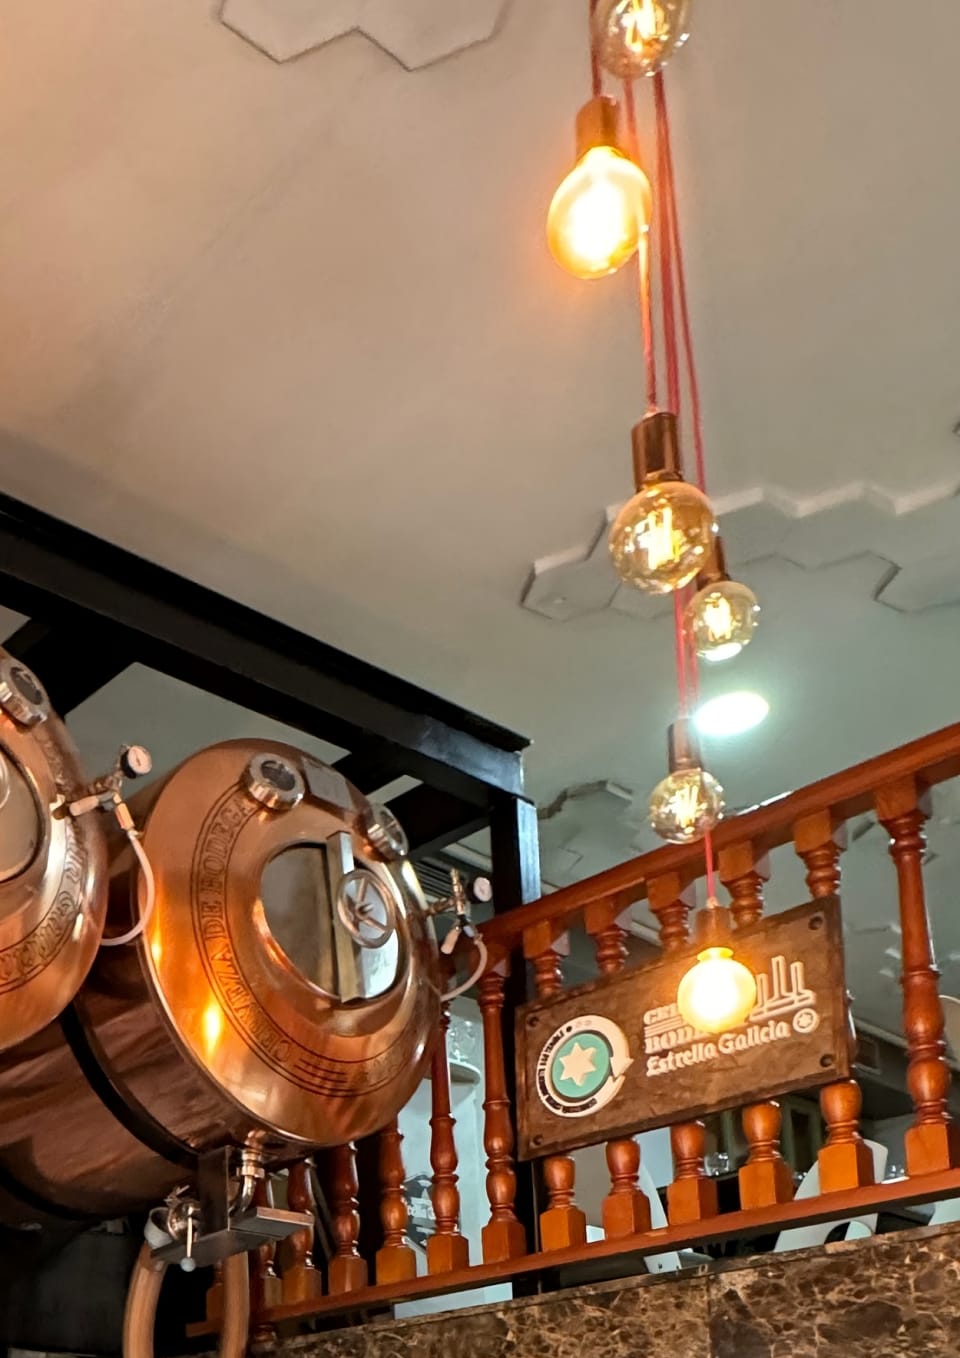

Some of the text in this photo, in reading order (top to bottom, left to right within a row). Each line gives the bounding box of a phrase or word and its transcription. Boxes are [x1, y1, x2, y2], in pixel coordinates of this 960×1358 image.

[200, 797, 291, 1063] CERVEZA DE BODEGA
[645, 1020, 792, 1077] Estrella Galicia
